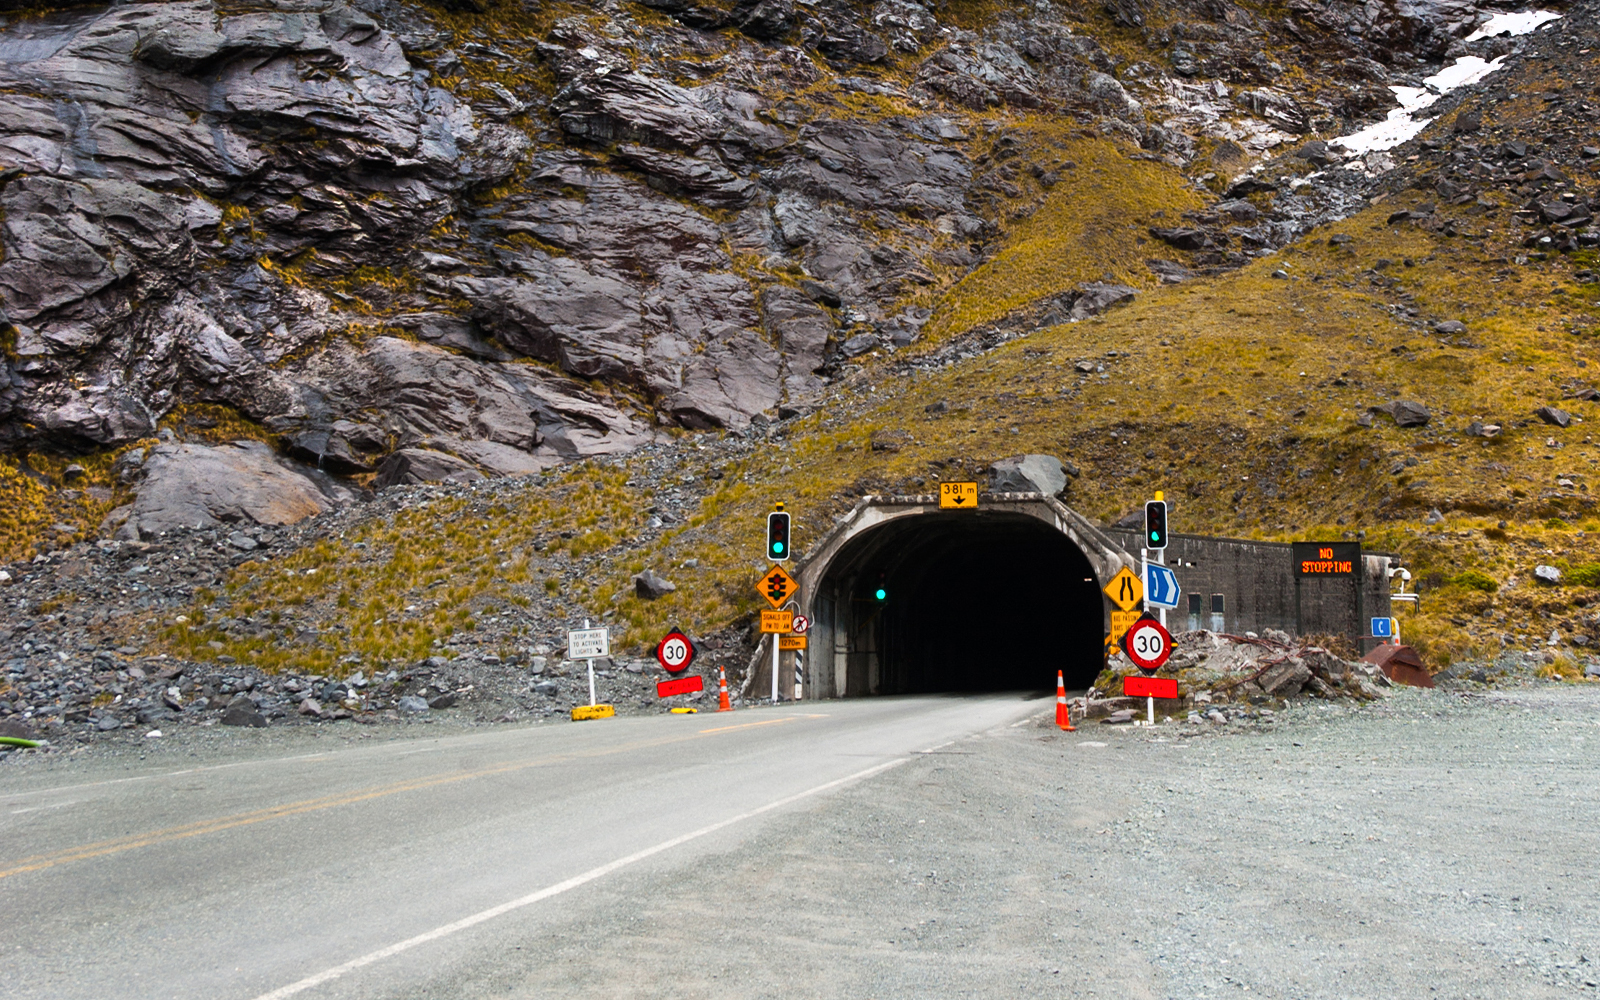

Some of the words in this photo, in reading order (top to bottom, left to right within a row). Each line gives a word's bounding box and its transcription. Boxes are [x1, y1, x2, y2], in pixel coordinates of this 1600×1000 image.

[1319, 548, 1333, 559] NO
[1302, 561, 1352, 573] STOPPING
[1137, 635, 1161, 653] 30
[666, 645, 684, 660] 30
